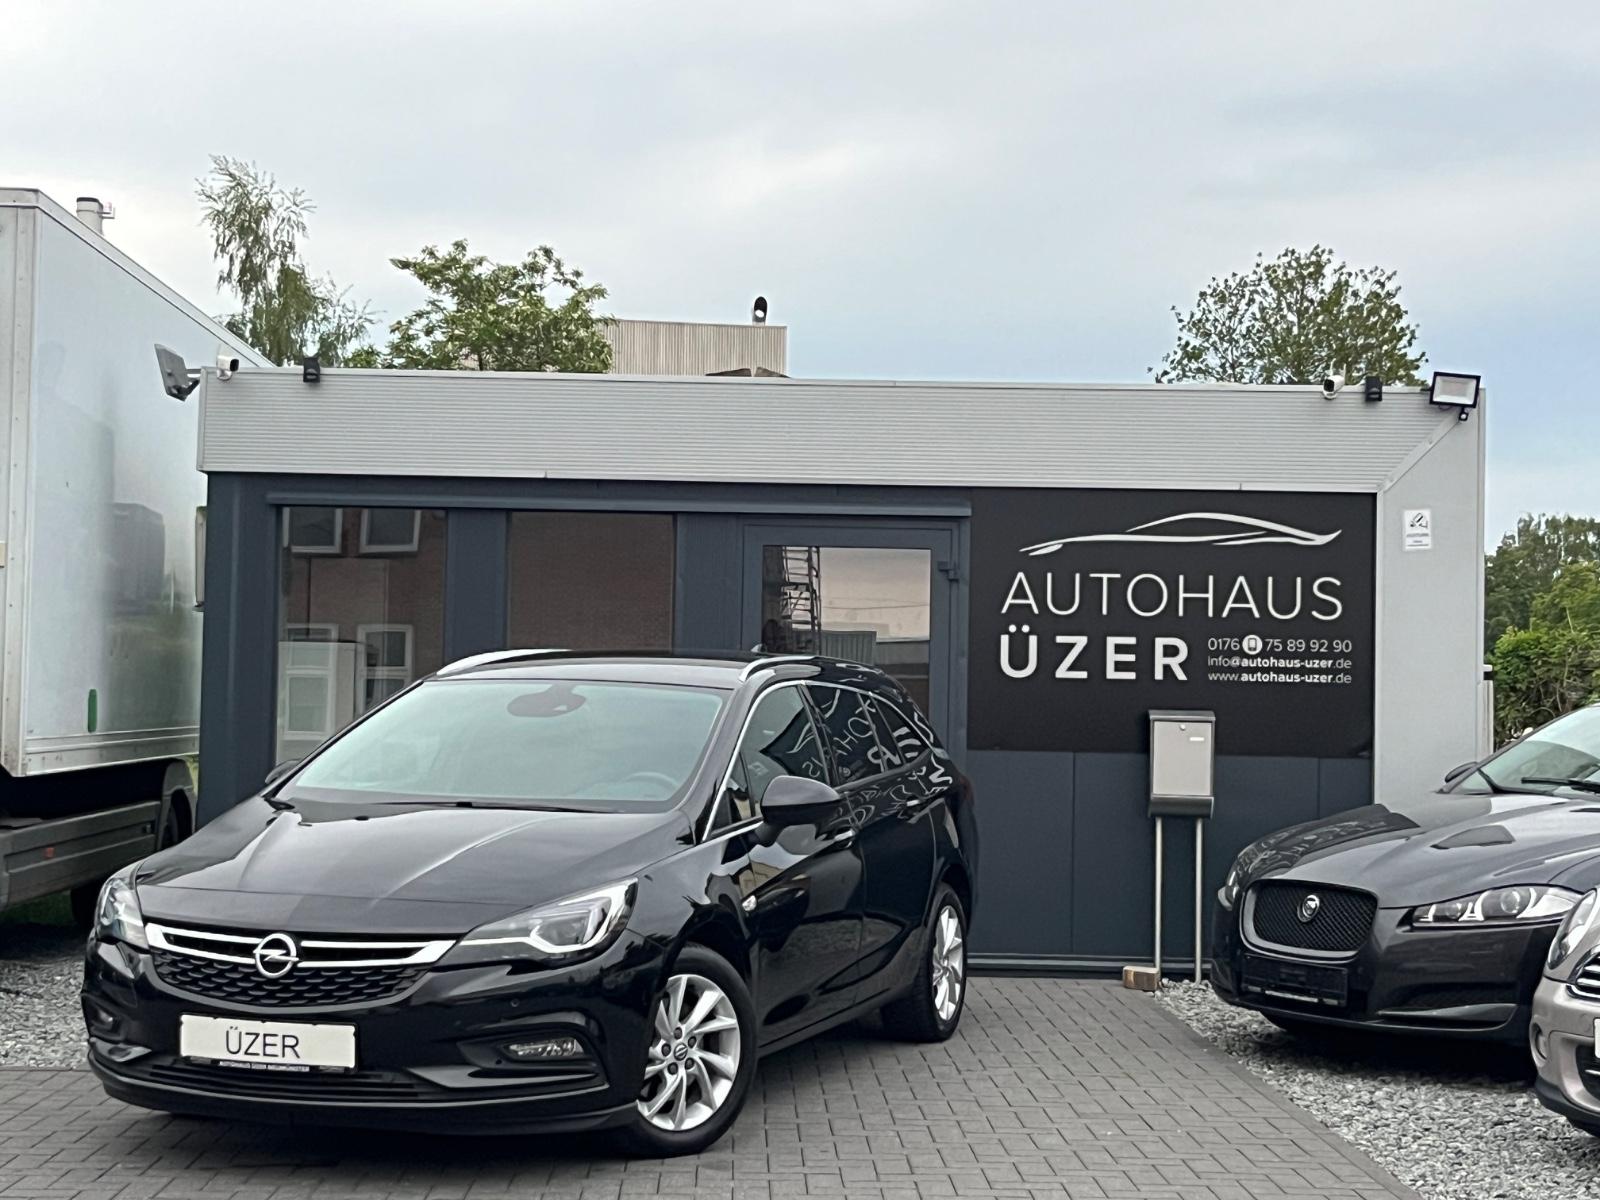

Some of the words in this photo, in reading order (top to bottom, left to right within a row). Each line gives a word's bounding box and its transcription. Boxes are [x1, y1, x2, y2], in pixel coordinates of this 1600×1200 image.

[1001, 571, 1343, 621] AUTOHAUS
[1000, 624, 1189, 681] ÜZER
[1207, 637, 1241, 651] 0176
[1265, 638, 1283, 652] 75
[1286, 639, 1306, 652] 89
[1309, 639, 1329, 653] 92
[1332, 639, 1353, 653] 90
[1207, 671, 1353, 684] www.autohaus-uzer.de
[225, 1026, 301, 1059] ÜZER
